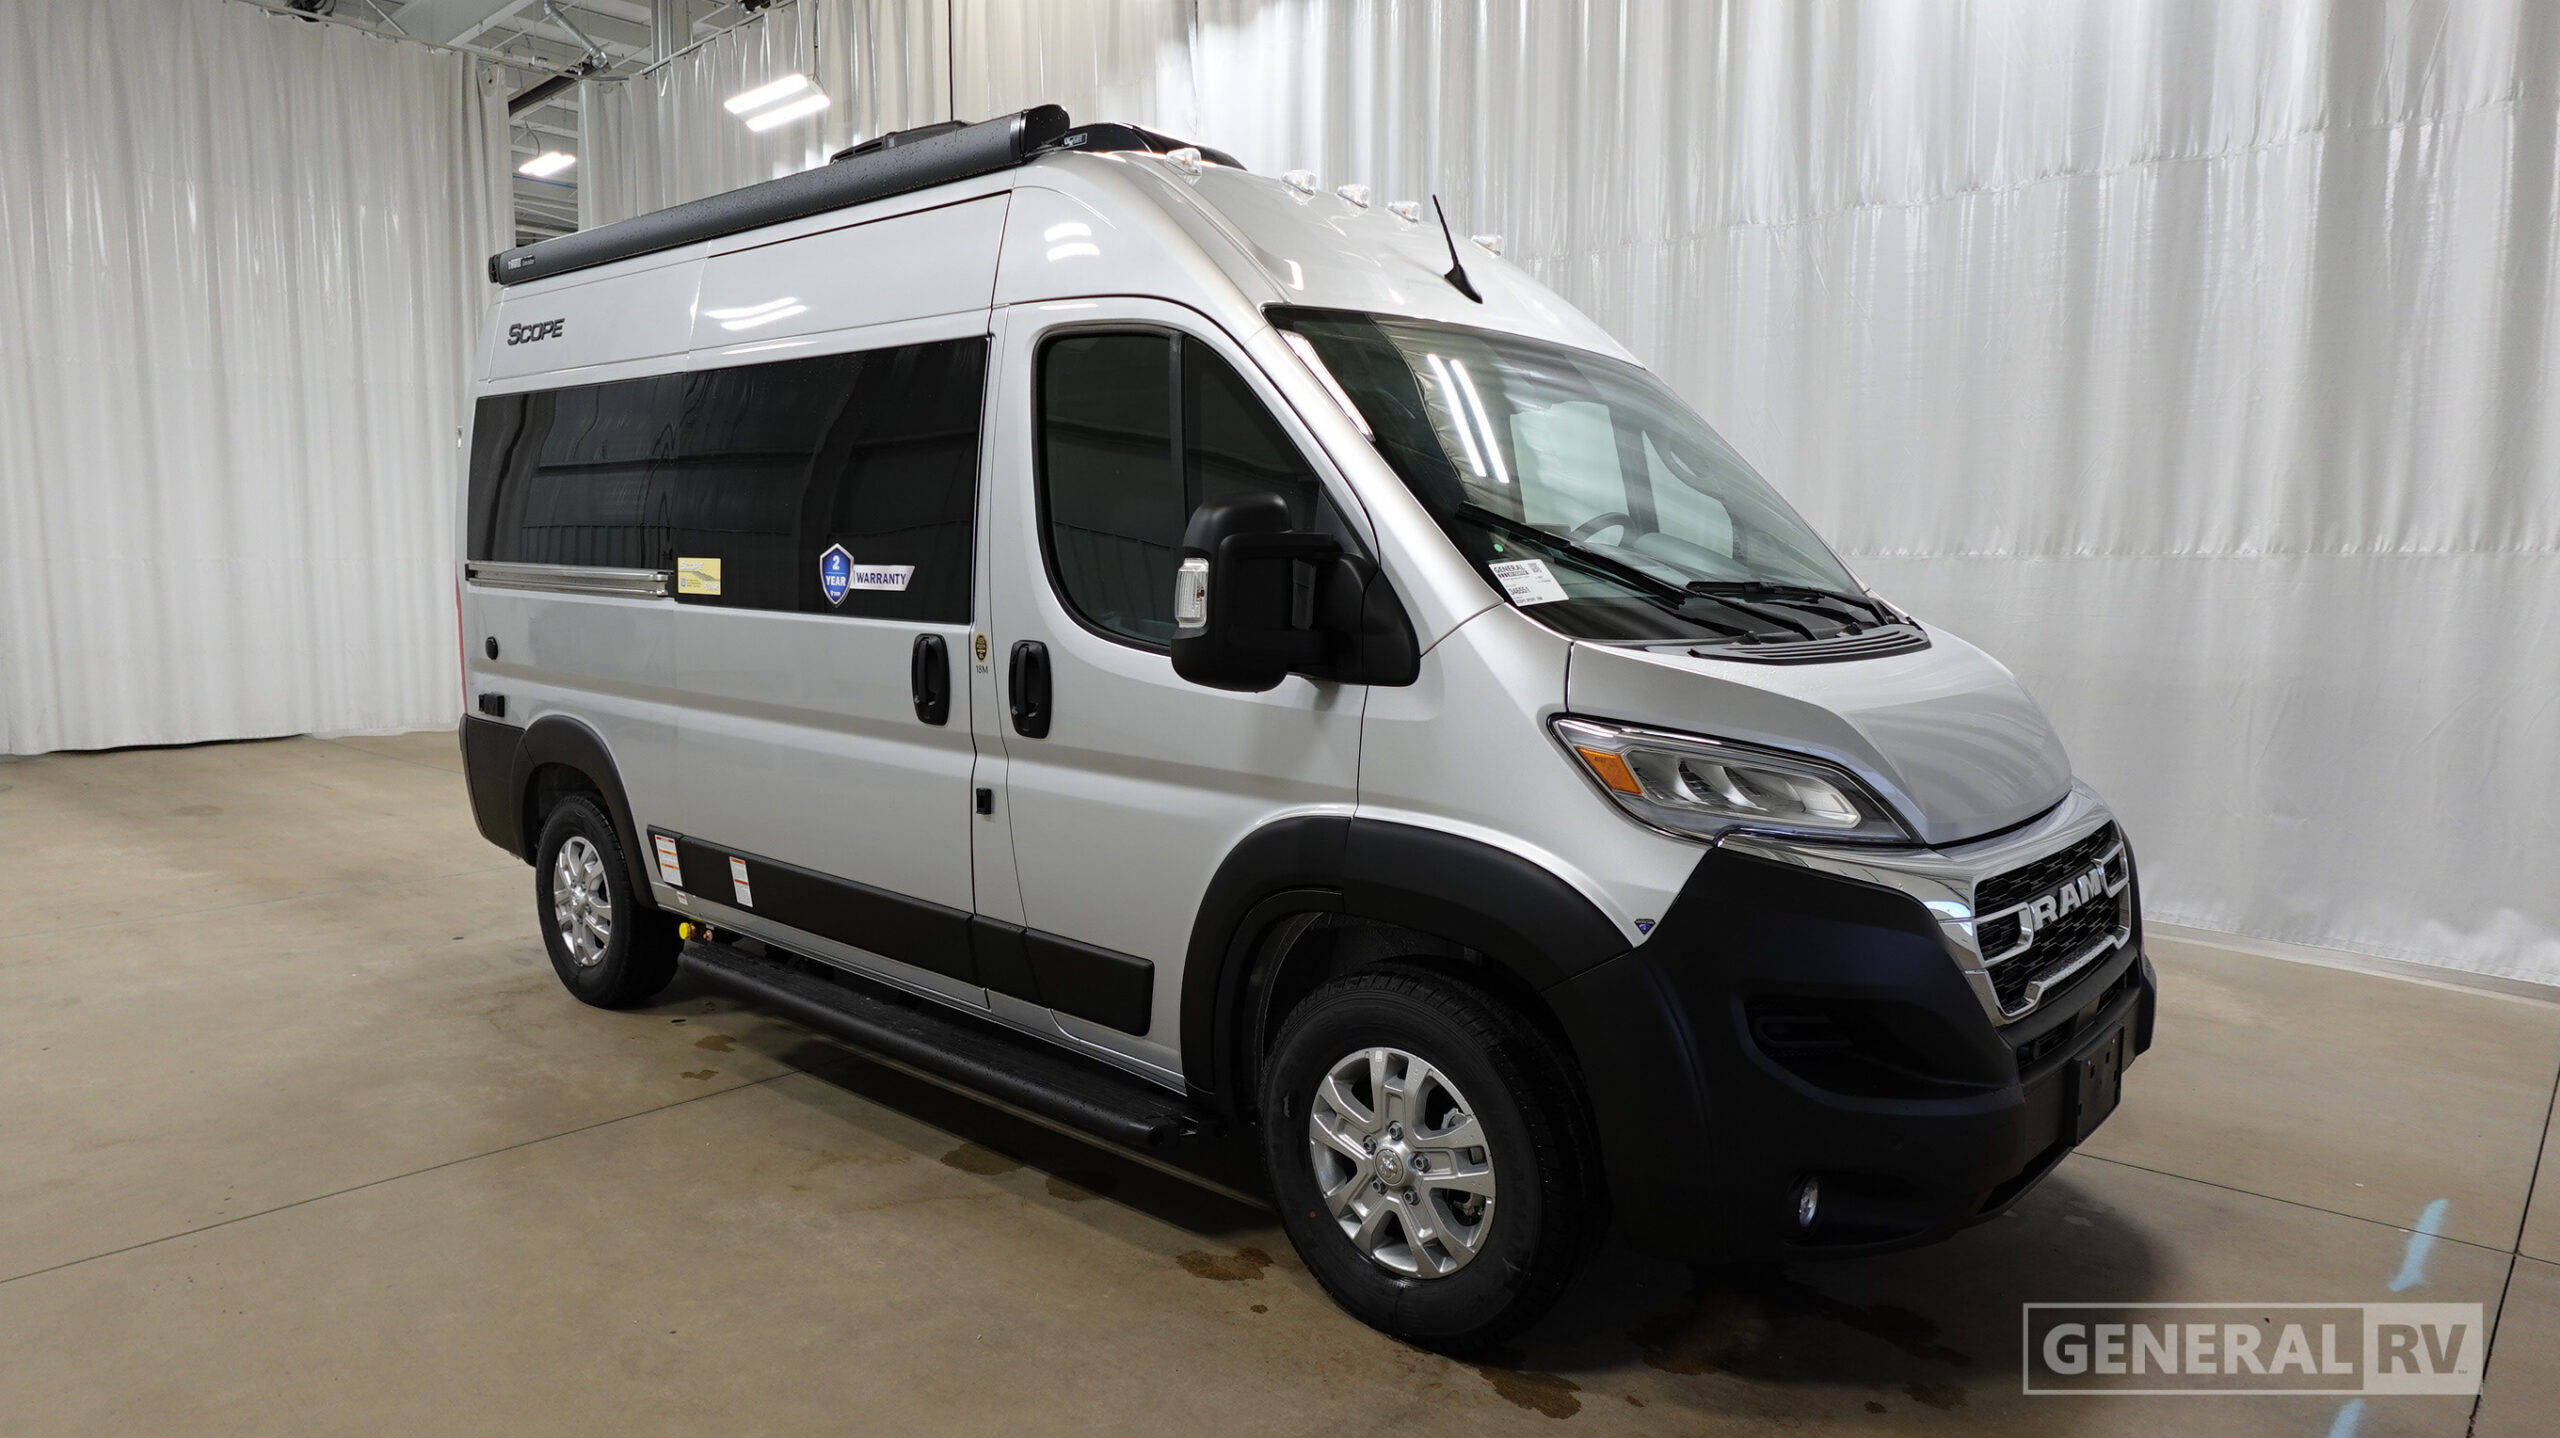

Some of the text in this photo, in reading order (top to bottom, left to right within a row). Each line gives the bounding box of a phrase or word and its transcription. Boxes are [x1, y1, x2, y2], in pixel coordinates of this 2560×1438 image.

[507, 318, 565, 346] SCOPE
[832, 555, 840, 570] 2
[1494, 563, 1525, 573] GENERAL
[826, 572, 907, 587] YEAR WARRANTY
[2029, 868, 2101, 932] RAM
